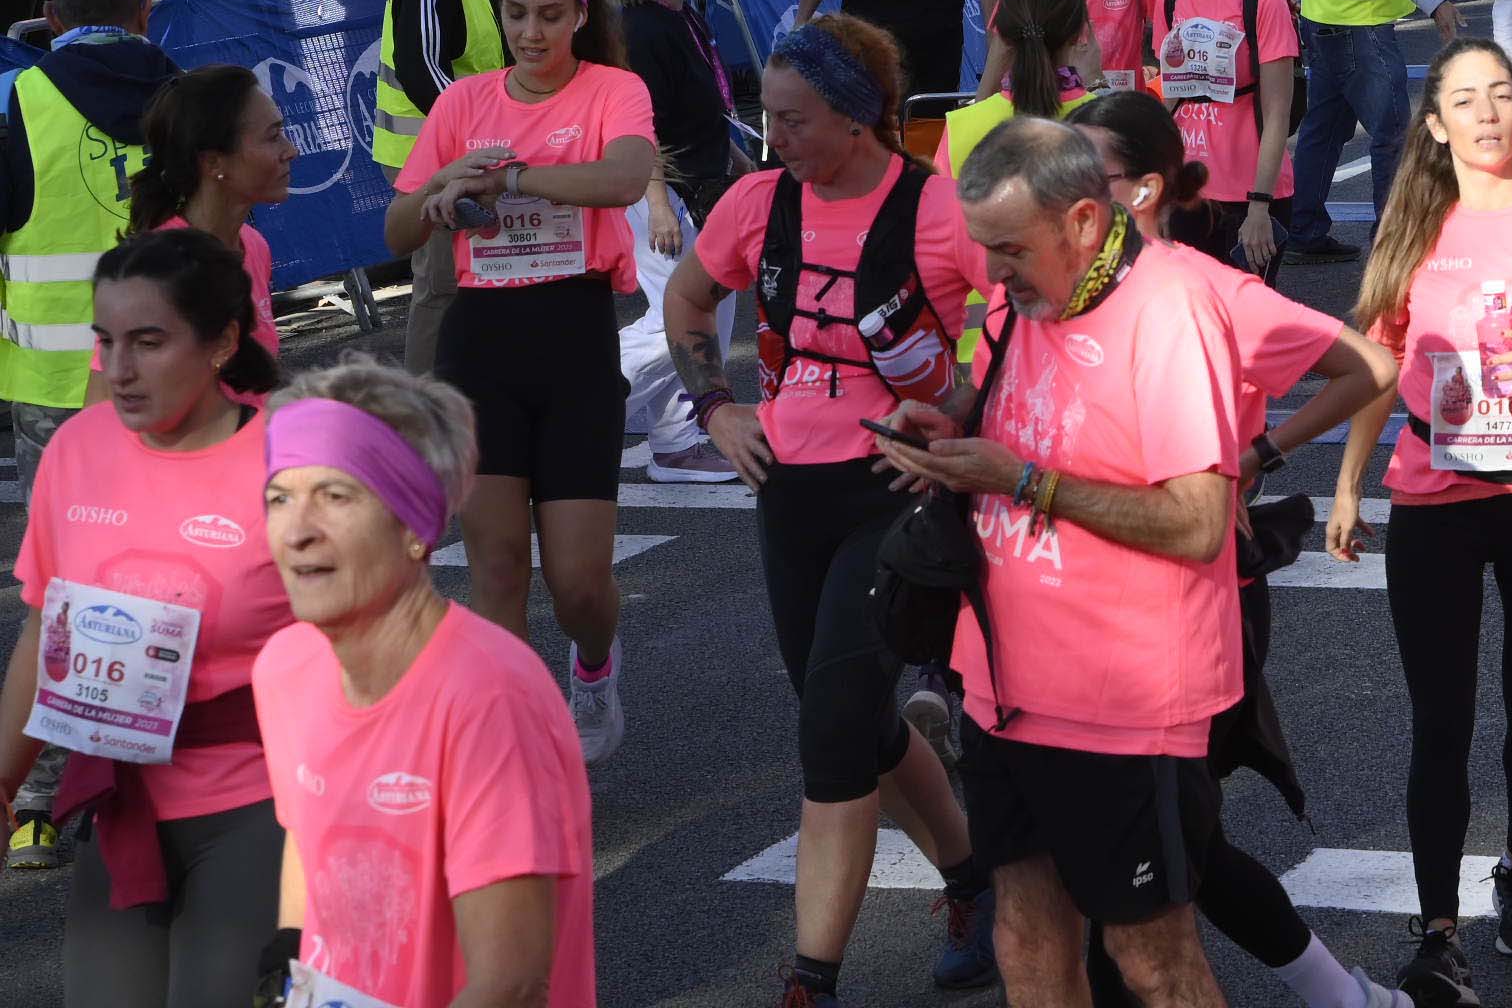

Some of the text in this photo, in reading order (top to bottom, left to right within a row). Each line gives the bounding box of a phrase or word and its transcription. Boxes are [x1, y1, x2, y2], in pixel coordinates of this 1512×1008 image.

[1187, 48, 1209, 62] 016
[466, 138, 511, 150] OYSHO
[502, 212, 543, 228] 016
[507, 232, 538, 244] 30801
[482, 247, 509, 256] CARRERA
[481, 262, 513, 273] OYSHO
[539, 258, 577, 269] Santander
[1485, 420, 1512, 432] 1477
[1447, 436, 1483, 444] CARRERA
[1484, 436, 1496, 444] DE
[1443, 451, 1484, 463] OYSHO
[66, 504, 129, 527] OYSHO
[974, 494, 1064, 571] UMA
[72, 652, 127, 683] 016
[75, 683, 109, 704] 3105
